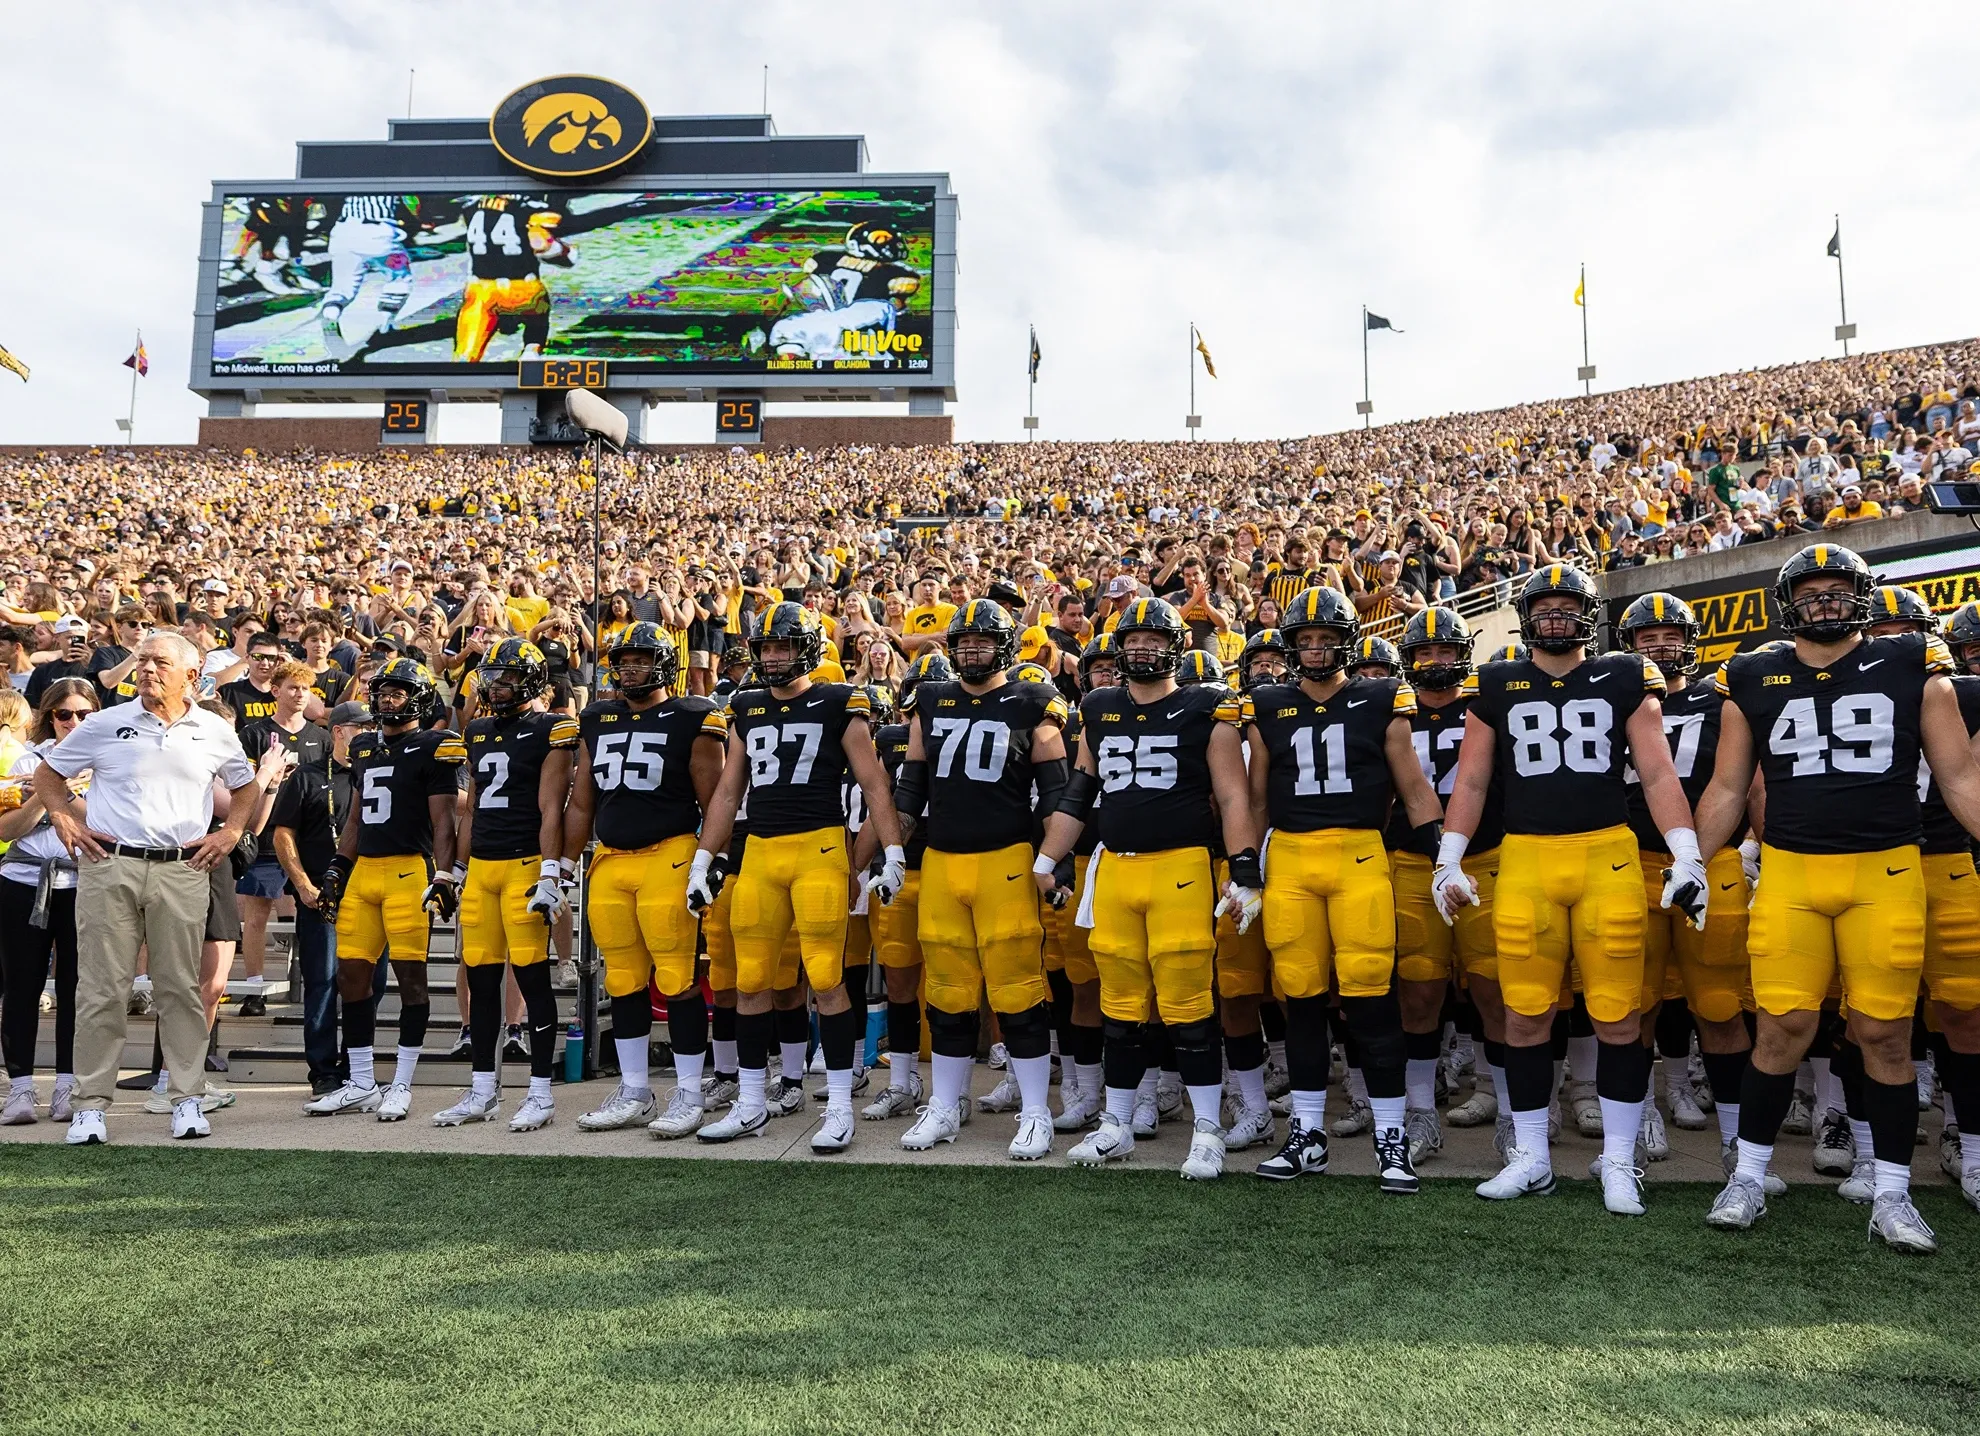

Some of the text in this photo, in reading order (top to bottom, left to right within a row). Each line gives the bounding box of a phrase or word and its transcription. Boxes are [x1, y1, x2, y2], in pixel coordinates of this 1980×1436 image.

[467, 210, 522, 255] 44
[215, 364, 229, 373] the
[231, 364, 270, 373] Midwest.
[297, 364, 313, 373] has
[543, 360, 600, 386] 6:26
[767, 360, 795, 369] ILLINOIS
[796, 360, 814, 369] STATE
[834, 360, 870, 369] OKLAHOMA
[908, 360, 928, 368] 12:00
[388, 403, 420, 428] 25
[721, 403, 754, 427] 25
[1692, 590, 1767, 637] WA
[1906, 575, 1980, 606] WA
[245, 701, 278, 717] IOW
[1769, 693, 1895, 777] 49
[593, 731, 668, 791] 55
[746, 723, 823, 787] 87
[930, 717, 1011, 783] 70
[1290, 723, 1353, 796] 11
[1508, 698, 1613, 777] 88
[478, 751, 510, 809] 2
[1098, 735, 1178, 793] 65
[362, 766, 394, 824] 5
